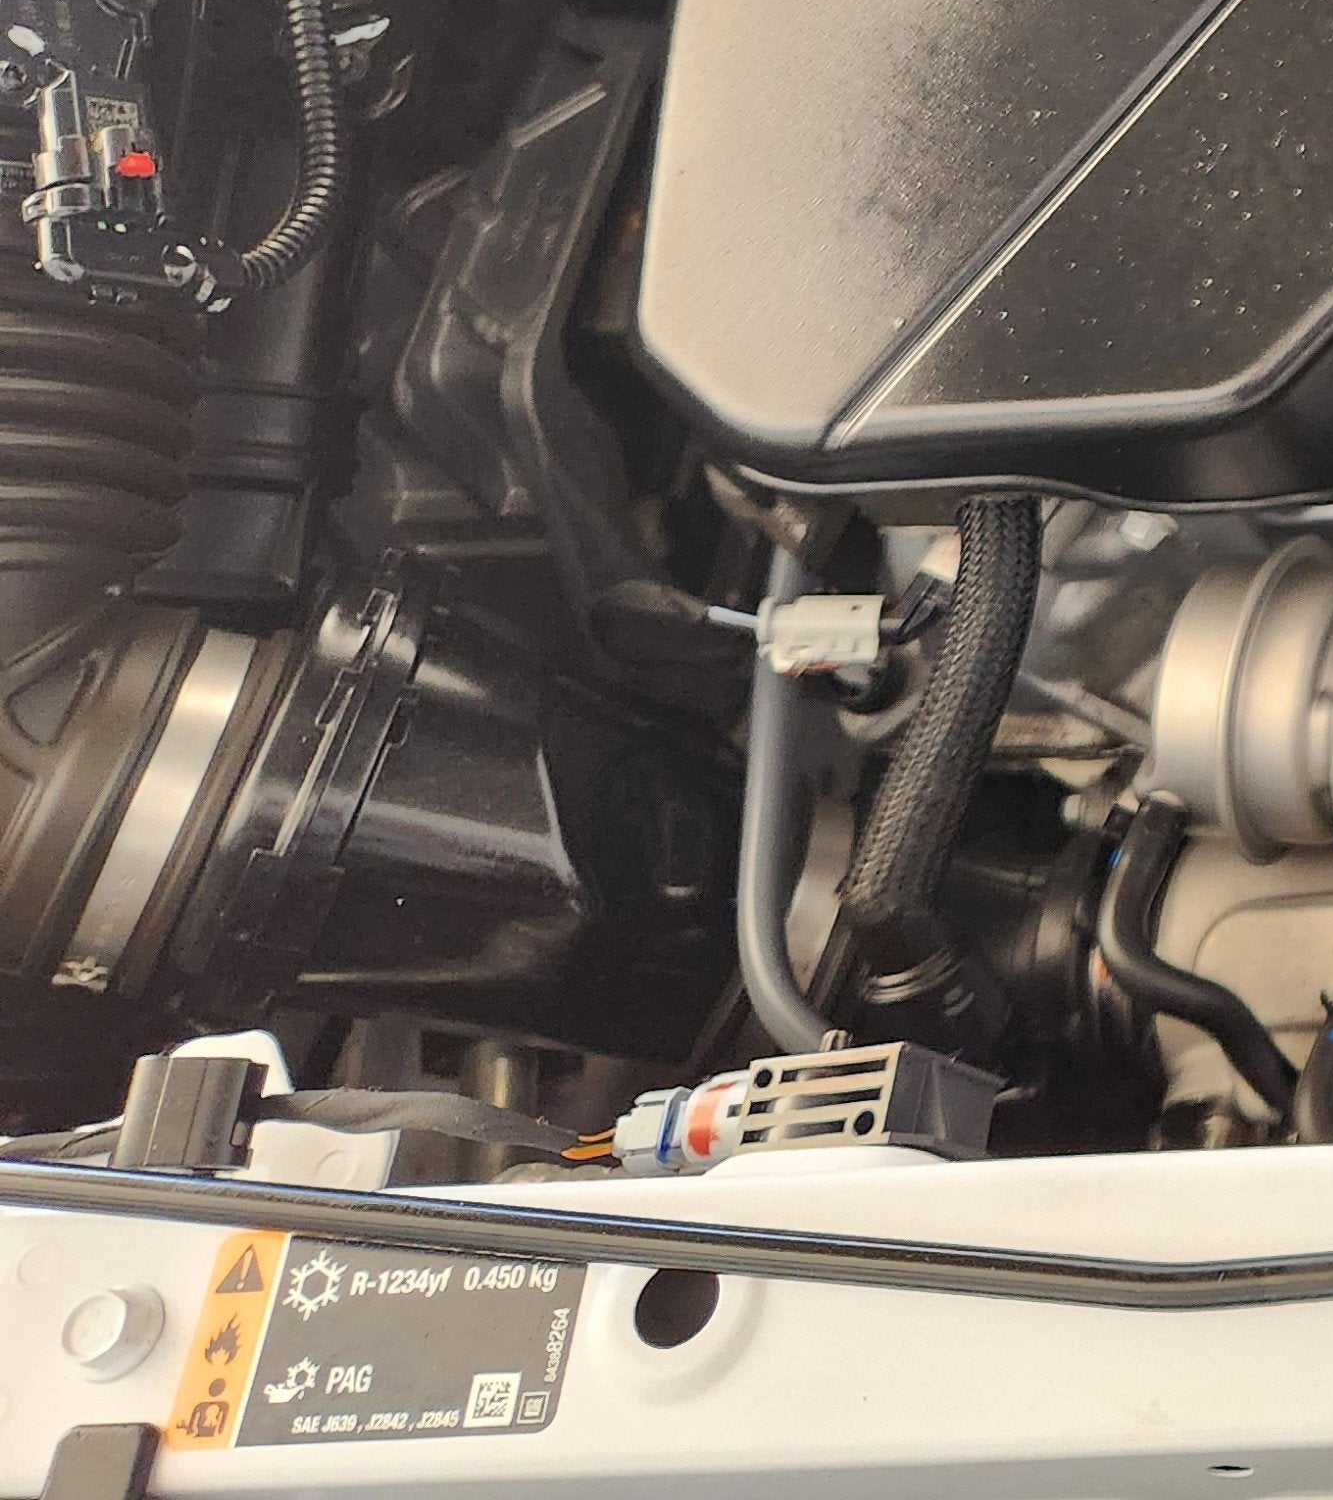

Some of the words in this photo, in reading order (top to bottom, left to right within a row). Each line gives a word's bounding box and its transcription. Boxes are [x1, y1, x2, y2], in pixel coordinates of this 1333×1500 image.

[349, 1265, 453, 1298] R-1234yf
[463, 1264, 527, 1291] 0.450
[528, 1262, 560, 1293] kg
[324, 1364, 374, 1395] PAG
[291, 1415, 321, 1435] SAE
[416, 1408, 461, 1430] J2845
